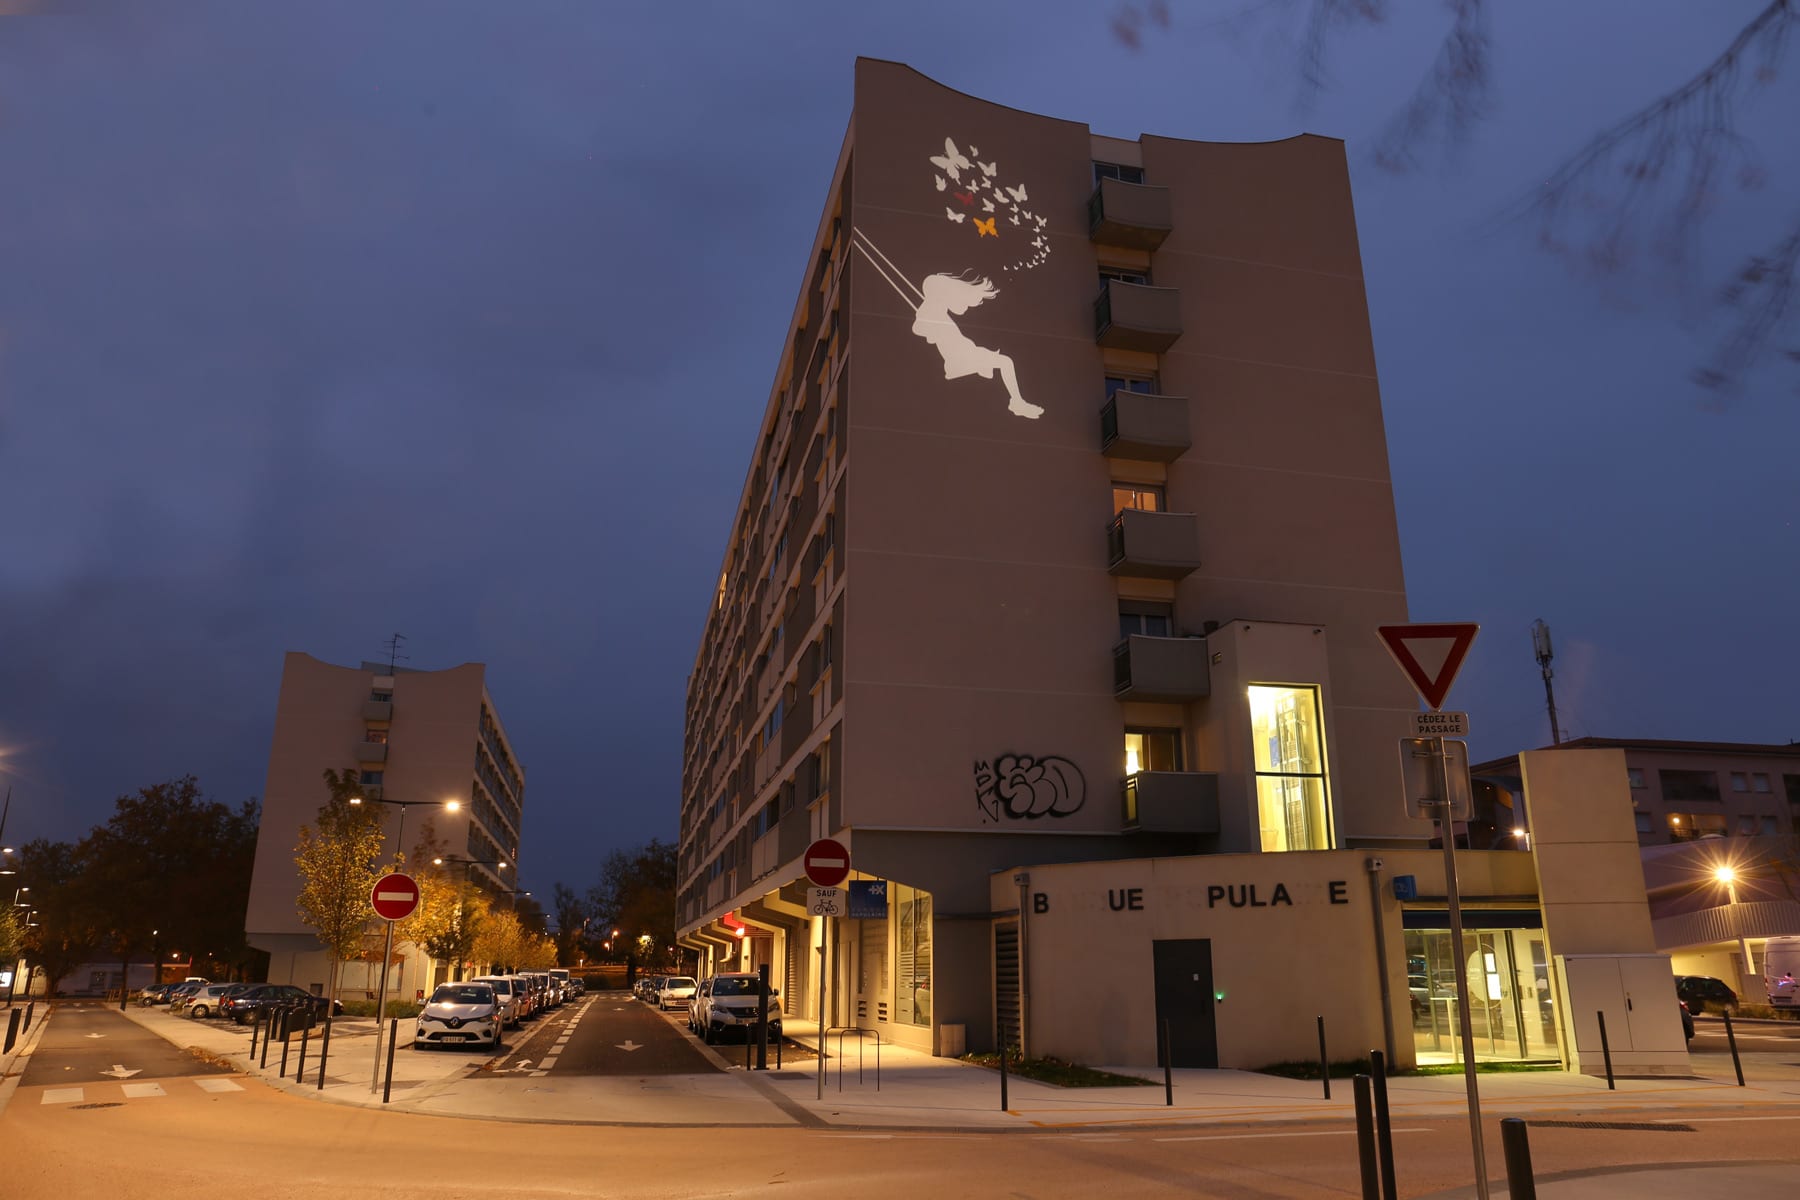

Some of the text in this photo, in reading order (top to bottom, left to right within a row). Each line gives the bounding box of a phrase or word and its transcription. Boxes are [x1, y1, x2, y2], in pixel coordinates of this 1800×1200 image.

[1417, 714, 1446, 723] CÉDEZ
[1418, 725, 1462, 733] PASSAGE
[816, 889, 837, 897] SAUF
